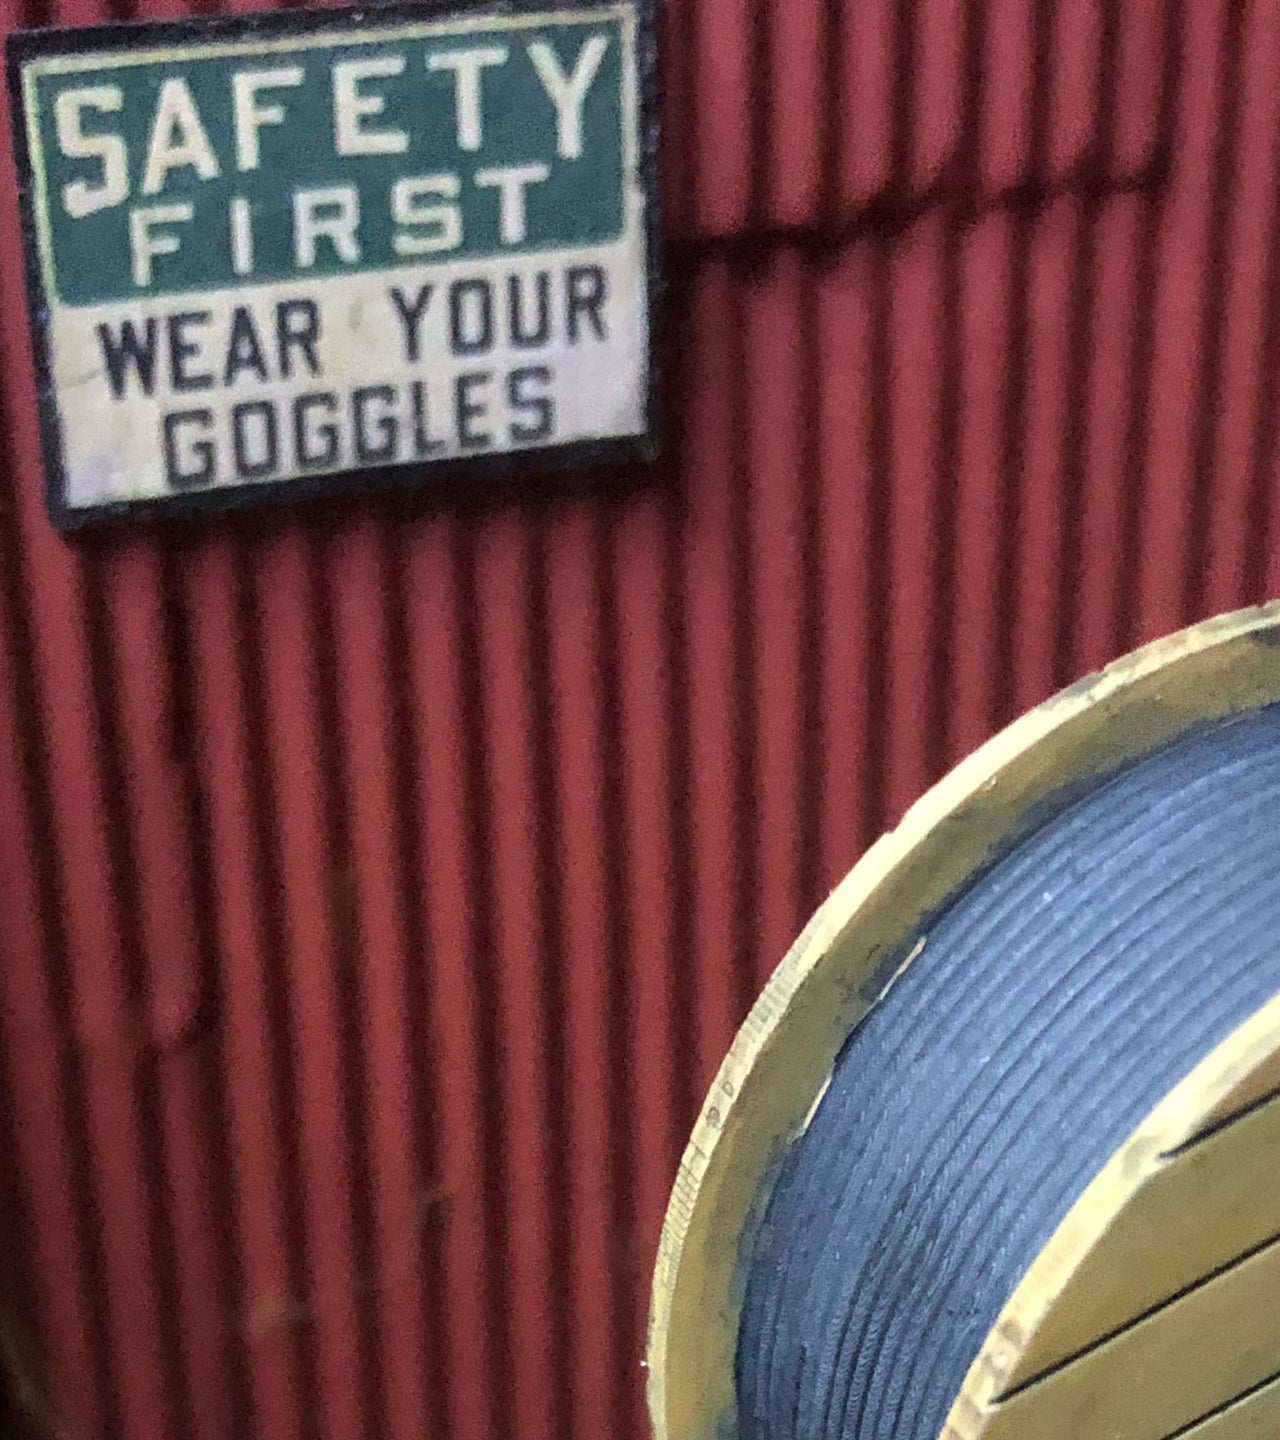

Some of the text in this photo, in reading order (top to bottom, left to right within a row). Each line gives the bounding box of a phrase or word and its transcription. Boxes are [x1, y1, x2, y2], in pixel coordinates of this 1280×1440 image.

[55, 36, 609, 219] SAFETY
[128, 163, 551, 287] FIRST
[96, 263, 610, 402] WEAR YOUR
[162, 365, 557, 492] GOGGLES
